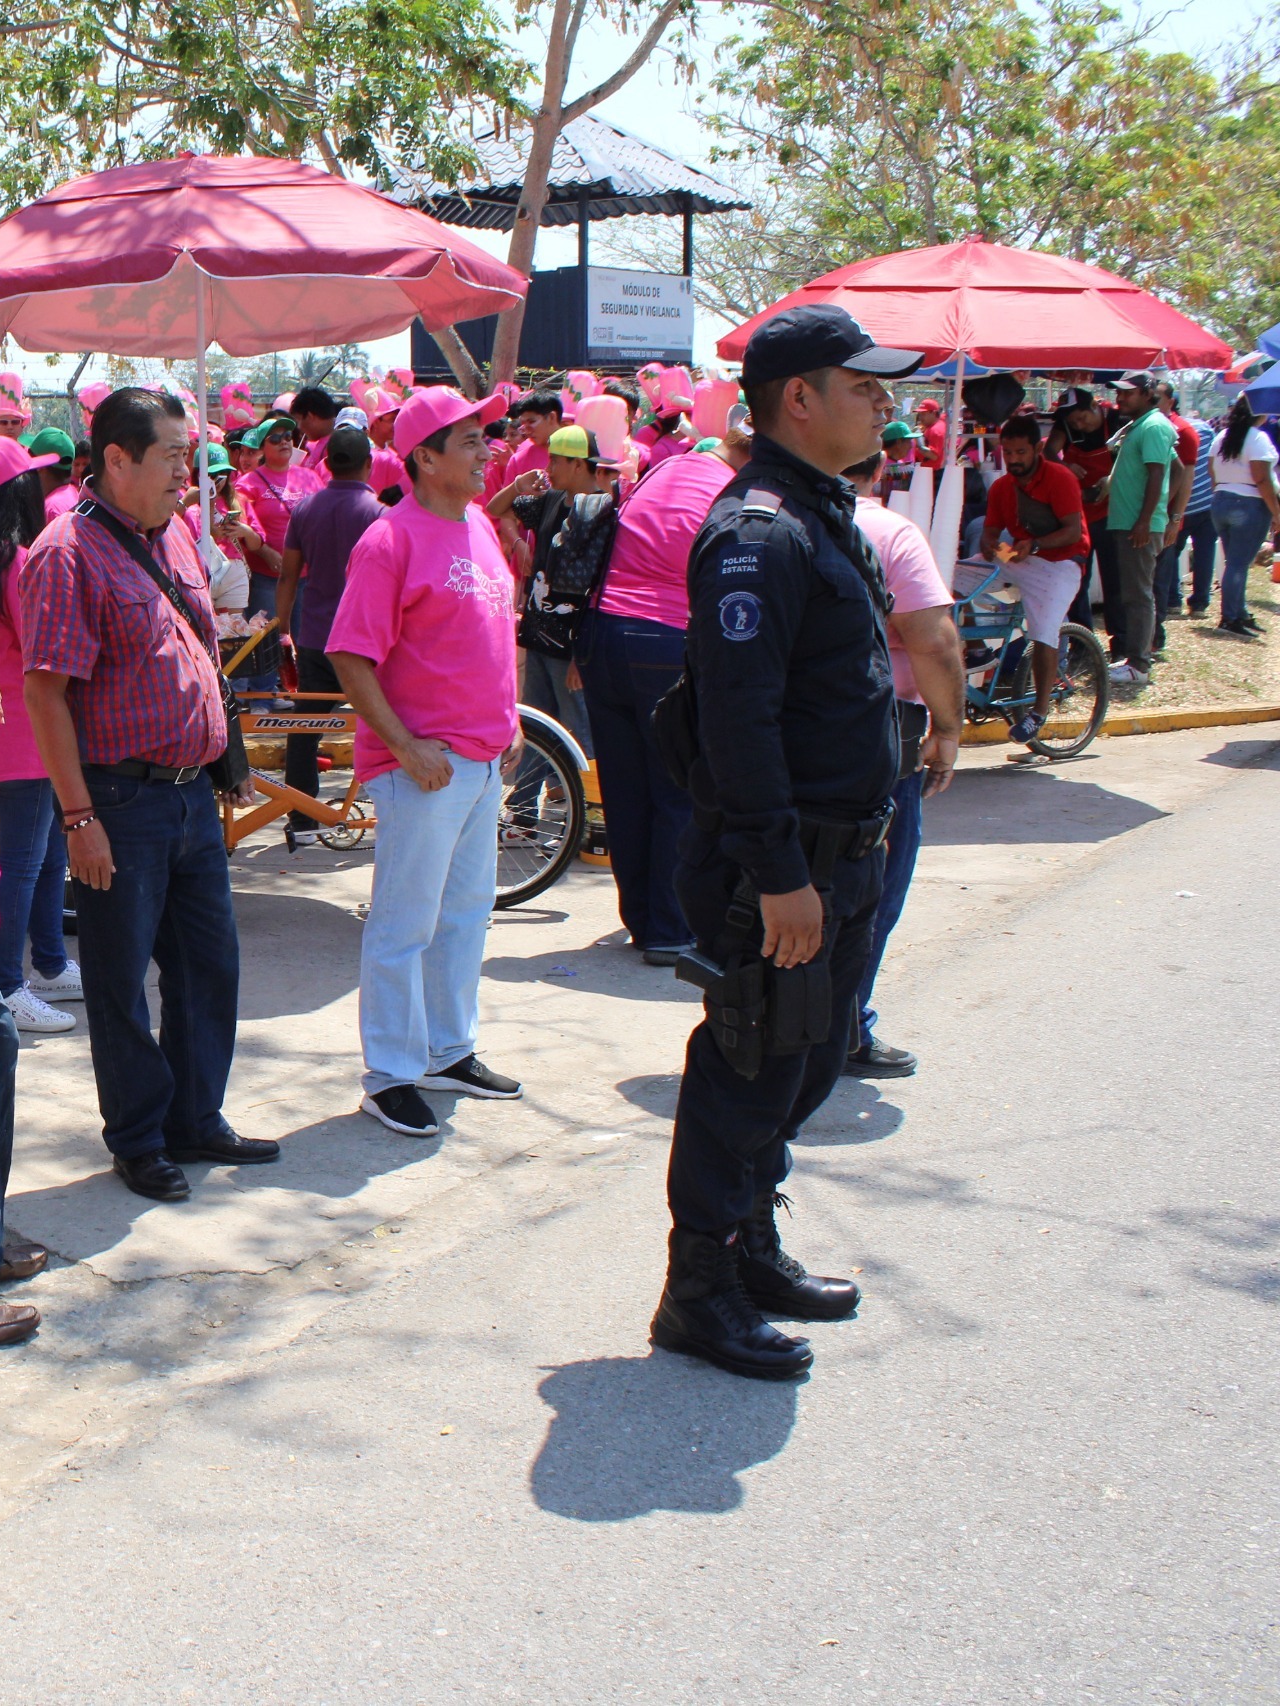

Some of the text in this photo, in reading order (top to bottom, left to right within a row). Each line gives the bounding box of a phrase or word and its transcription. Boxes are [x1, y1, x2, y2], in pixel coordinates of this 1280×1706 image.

[622, 282, 660, 298] MÓDULO DE
[601, 302, 680, 319] SEGURIDAD Y VIGILANCIA
[723, 555, 758, 566] POLICÍA
[722, 565, 758, 575] ESTATAL
